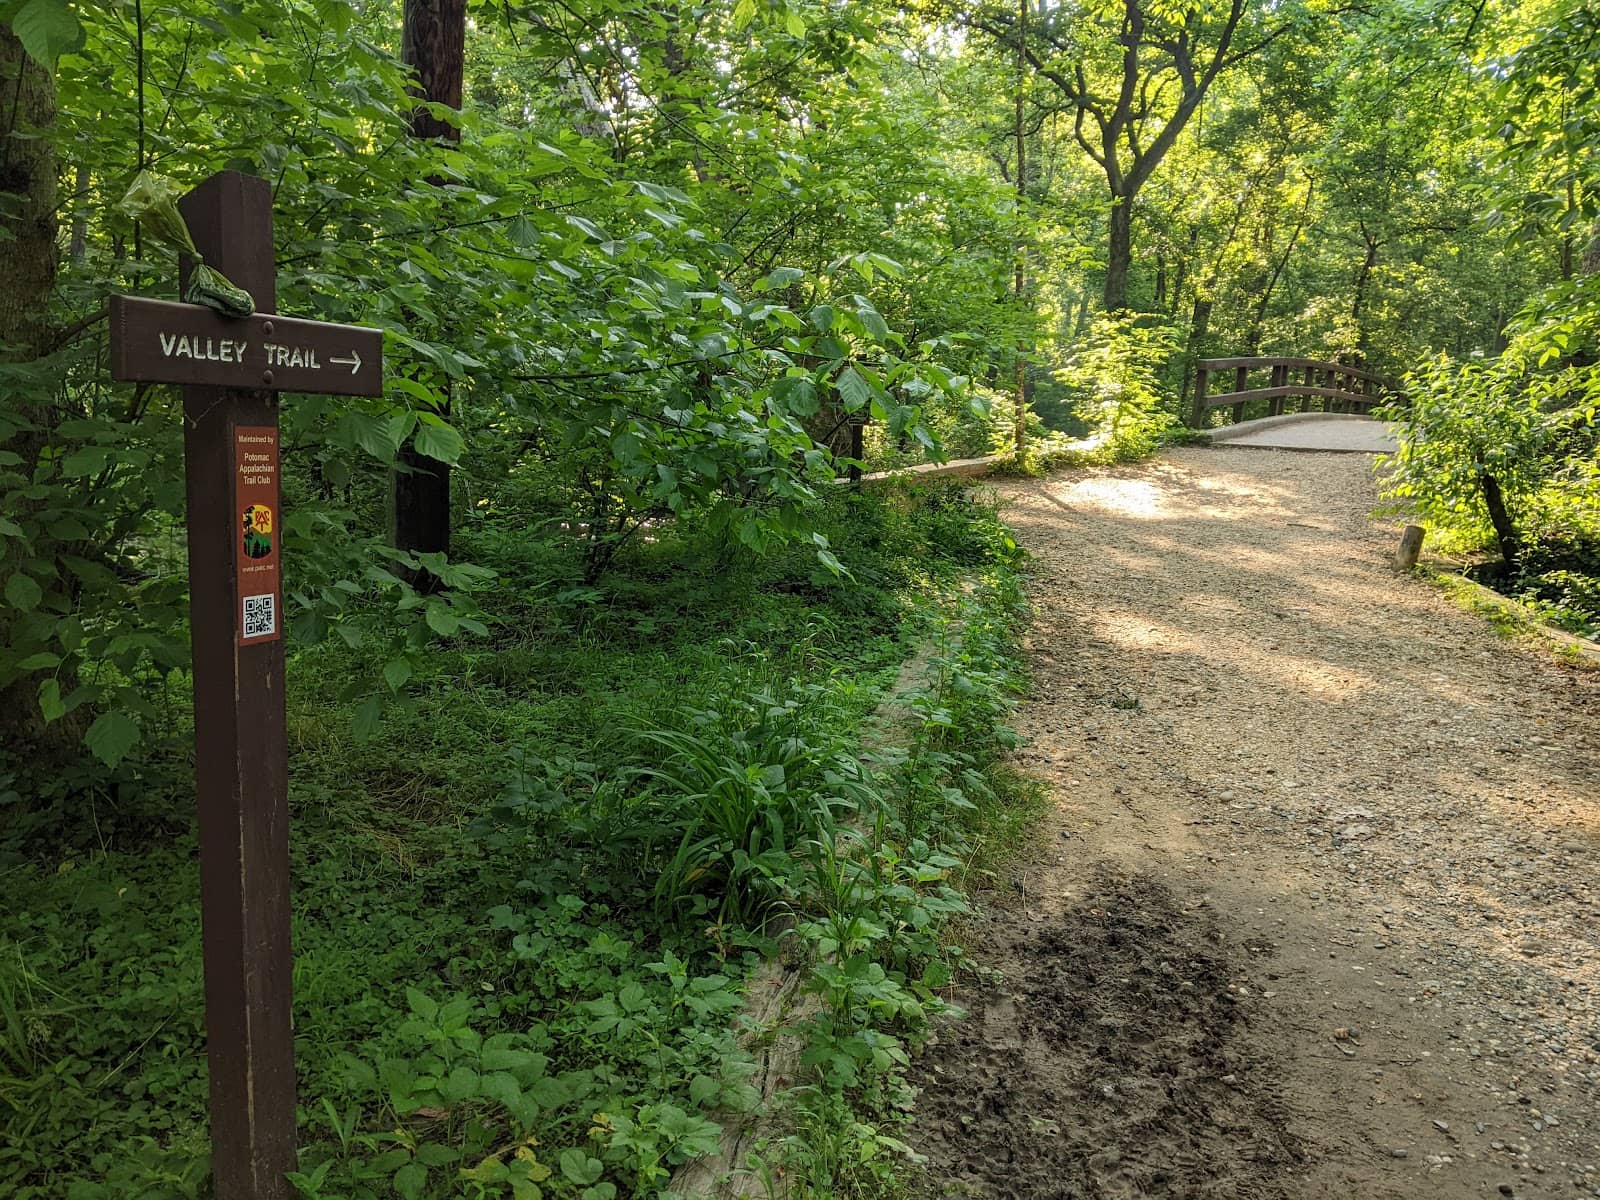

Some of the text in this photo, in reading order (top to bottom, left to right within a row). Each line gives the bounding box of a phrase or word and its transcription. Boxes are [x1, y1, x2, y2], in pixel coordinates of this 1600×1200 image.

[159, 332, 321, 369] VALLEY TRAIL
[238, 435, 274, 444] Maintained by
[244, 452, 270, 462] Potomac
[240, 464, 275, 474] Appalachian
[244, 475, 271, 485] Trail Club
